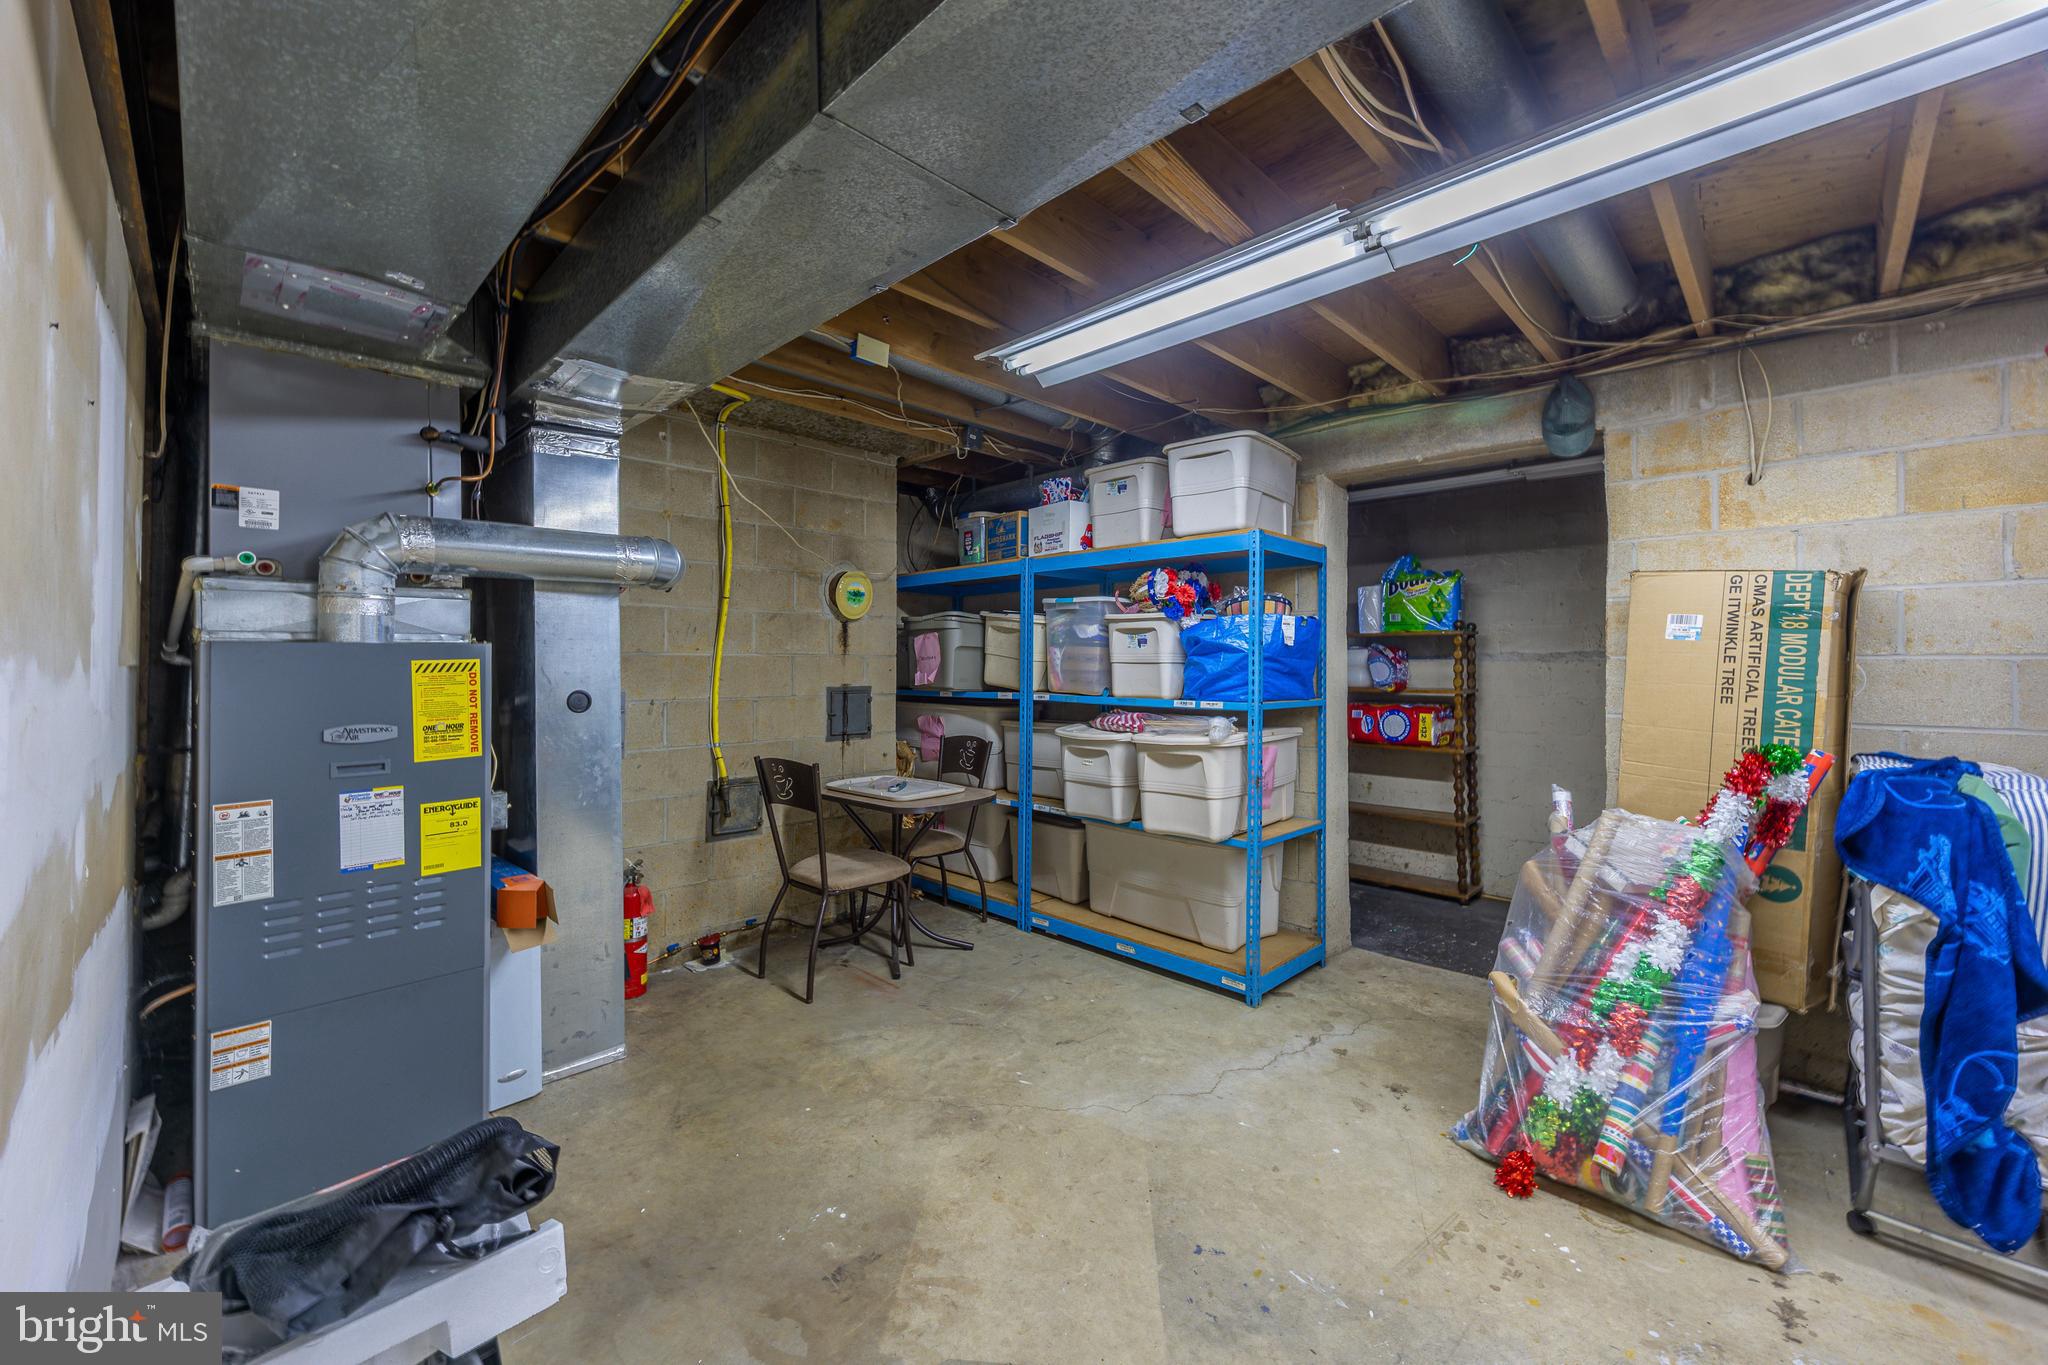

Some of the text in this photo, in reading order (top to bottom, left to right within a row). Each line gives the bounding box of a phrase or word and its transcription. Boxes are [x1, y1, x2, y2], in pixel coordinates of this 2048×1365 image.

[1729, 574, 1743, 594] GE
[1751, 574, 1767, 617] CMAS
[1745, 621, 1763, 703] ARTIFICIAL
[1773, 573, 1813, 752] DEPT 18 MODULAR CATE
[1720, 669, 1735, 705] TREE
[468, 672, 479, 753] DO NOT REMOVE
[342, 726, 393, 735] ARMSTRONG
[445, 722, 465, 731] HOUR
[344, 734, 360, 742] AIR
[423, 801, 479, 815] ENERGYGUIDE
[449, 820, 468, 828] 83.0
